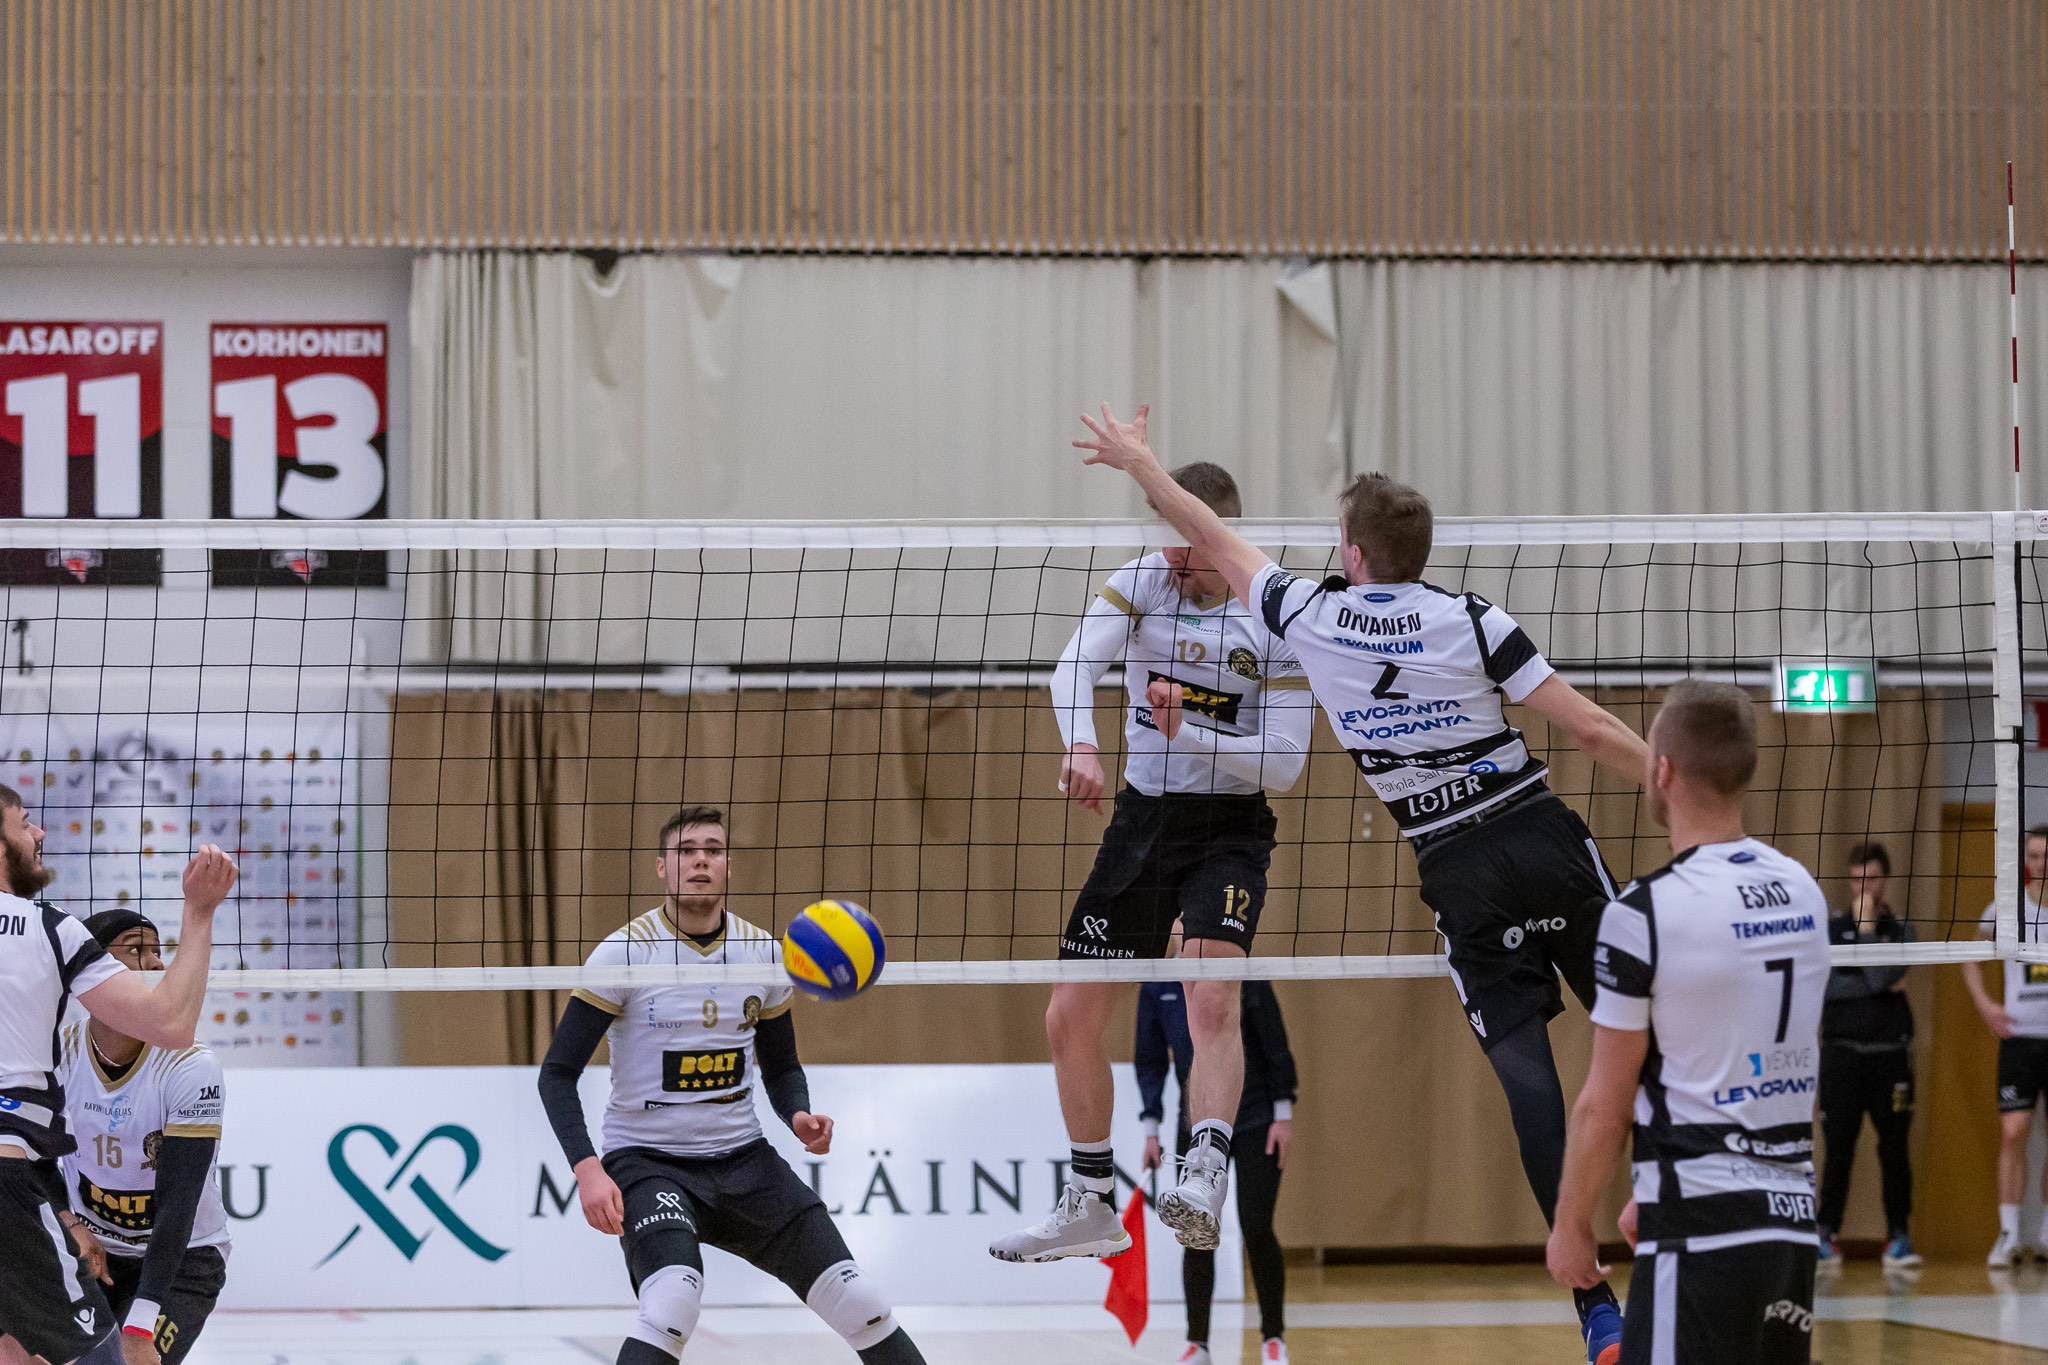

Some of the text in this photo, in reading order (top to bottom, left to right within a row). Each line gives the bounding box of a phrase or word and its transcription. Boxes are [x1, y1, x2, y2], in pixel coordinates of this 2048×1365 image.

[214, 330, 384, 357] KORHONEN
[6, 373, 141, 517] 11
[215, 373, 385, 519] 13
[1177, 640, 1206, 664] 12
[1408, 775, 1483, 817] LOJER
[1223, 884, 1250, 921] 12
[1737, 881, 1791, 909] ESKO
[1222, 917, 1245, 932] JAKO
[1062, 939, 1134, 958] EHILÄINEN
[702, 1000, 718, 1029] 9
[1765, 958, 1794, 1043] 7
[679, 1053, 738, 1075] BOLT
[92, 1134, 122, 1168] 15
[153, 1314, 179, 1354] 15
